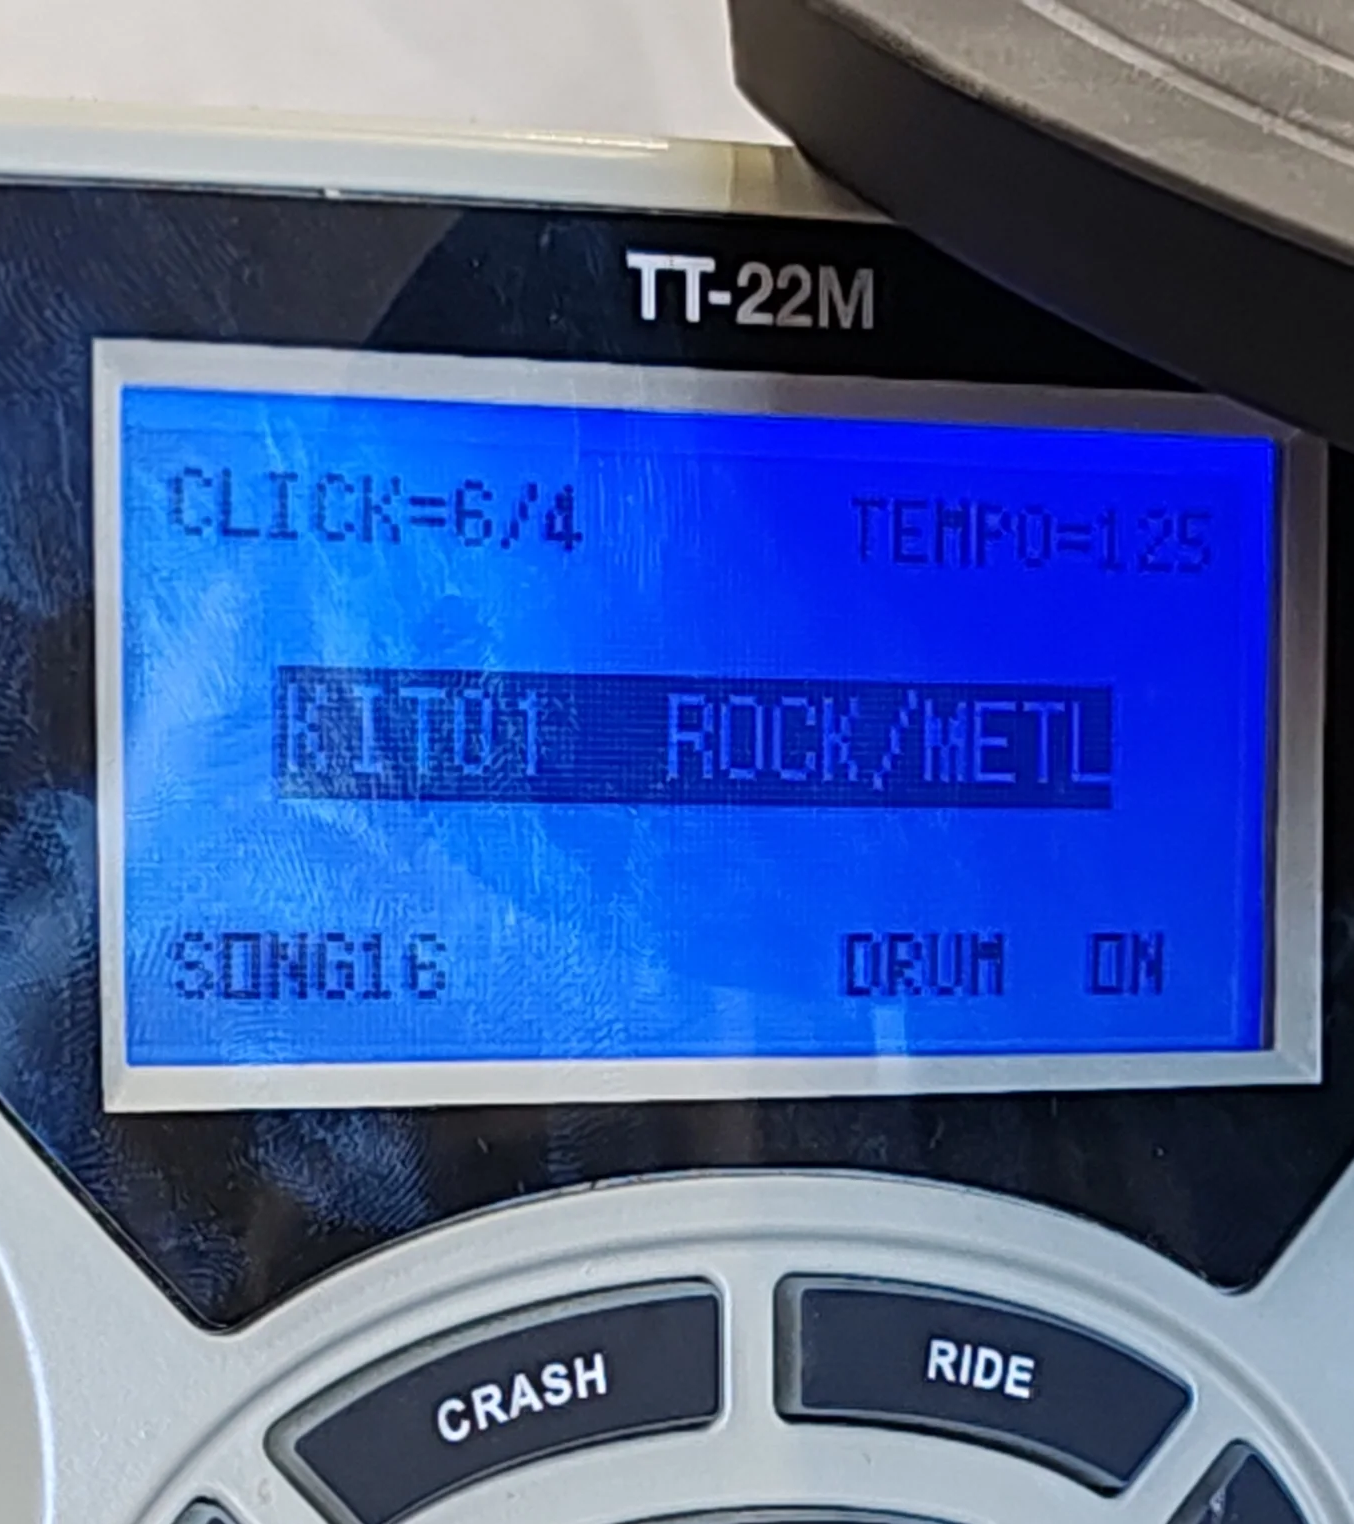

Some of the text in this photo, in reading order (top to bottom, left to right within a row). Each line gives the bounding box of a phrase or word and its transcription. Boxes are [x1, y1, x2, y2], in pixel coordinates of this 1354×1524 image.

[625, 251, 875, 330] TT-22M
[167, 468, 583, 553] CLICK=6/4
[851, 496, 1214, 574] TEMPO=125
[665, 690, 1109, 790] ROCK/METL
[167, 932, 447, 1002] SONG16
[845, 932, 1164, 997] DRUM ON
[434, 1352, 609, 1444] CRASH
[926, 1338, 1036, 1400] RIDE
